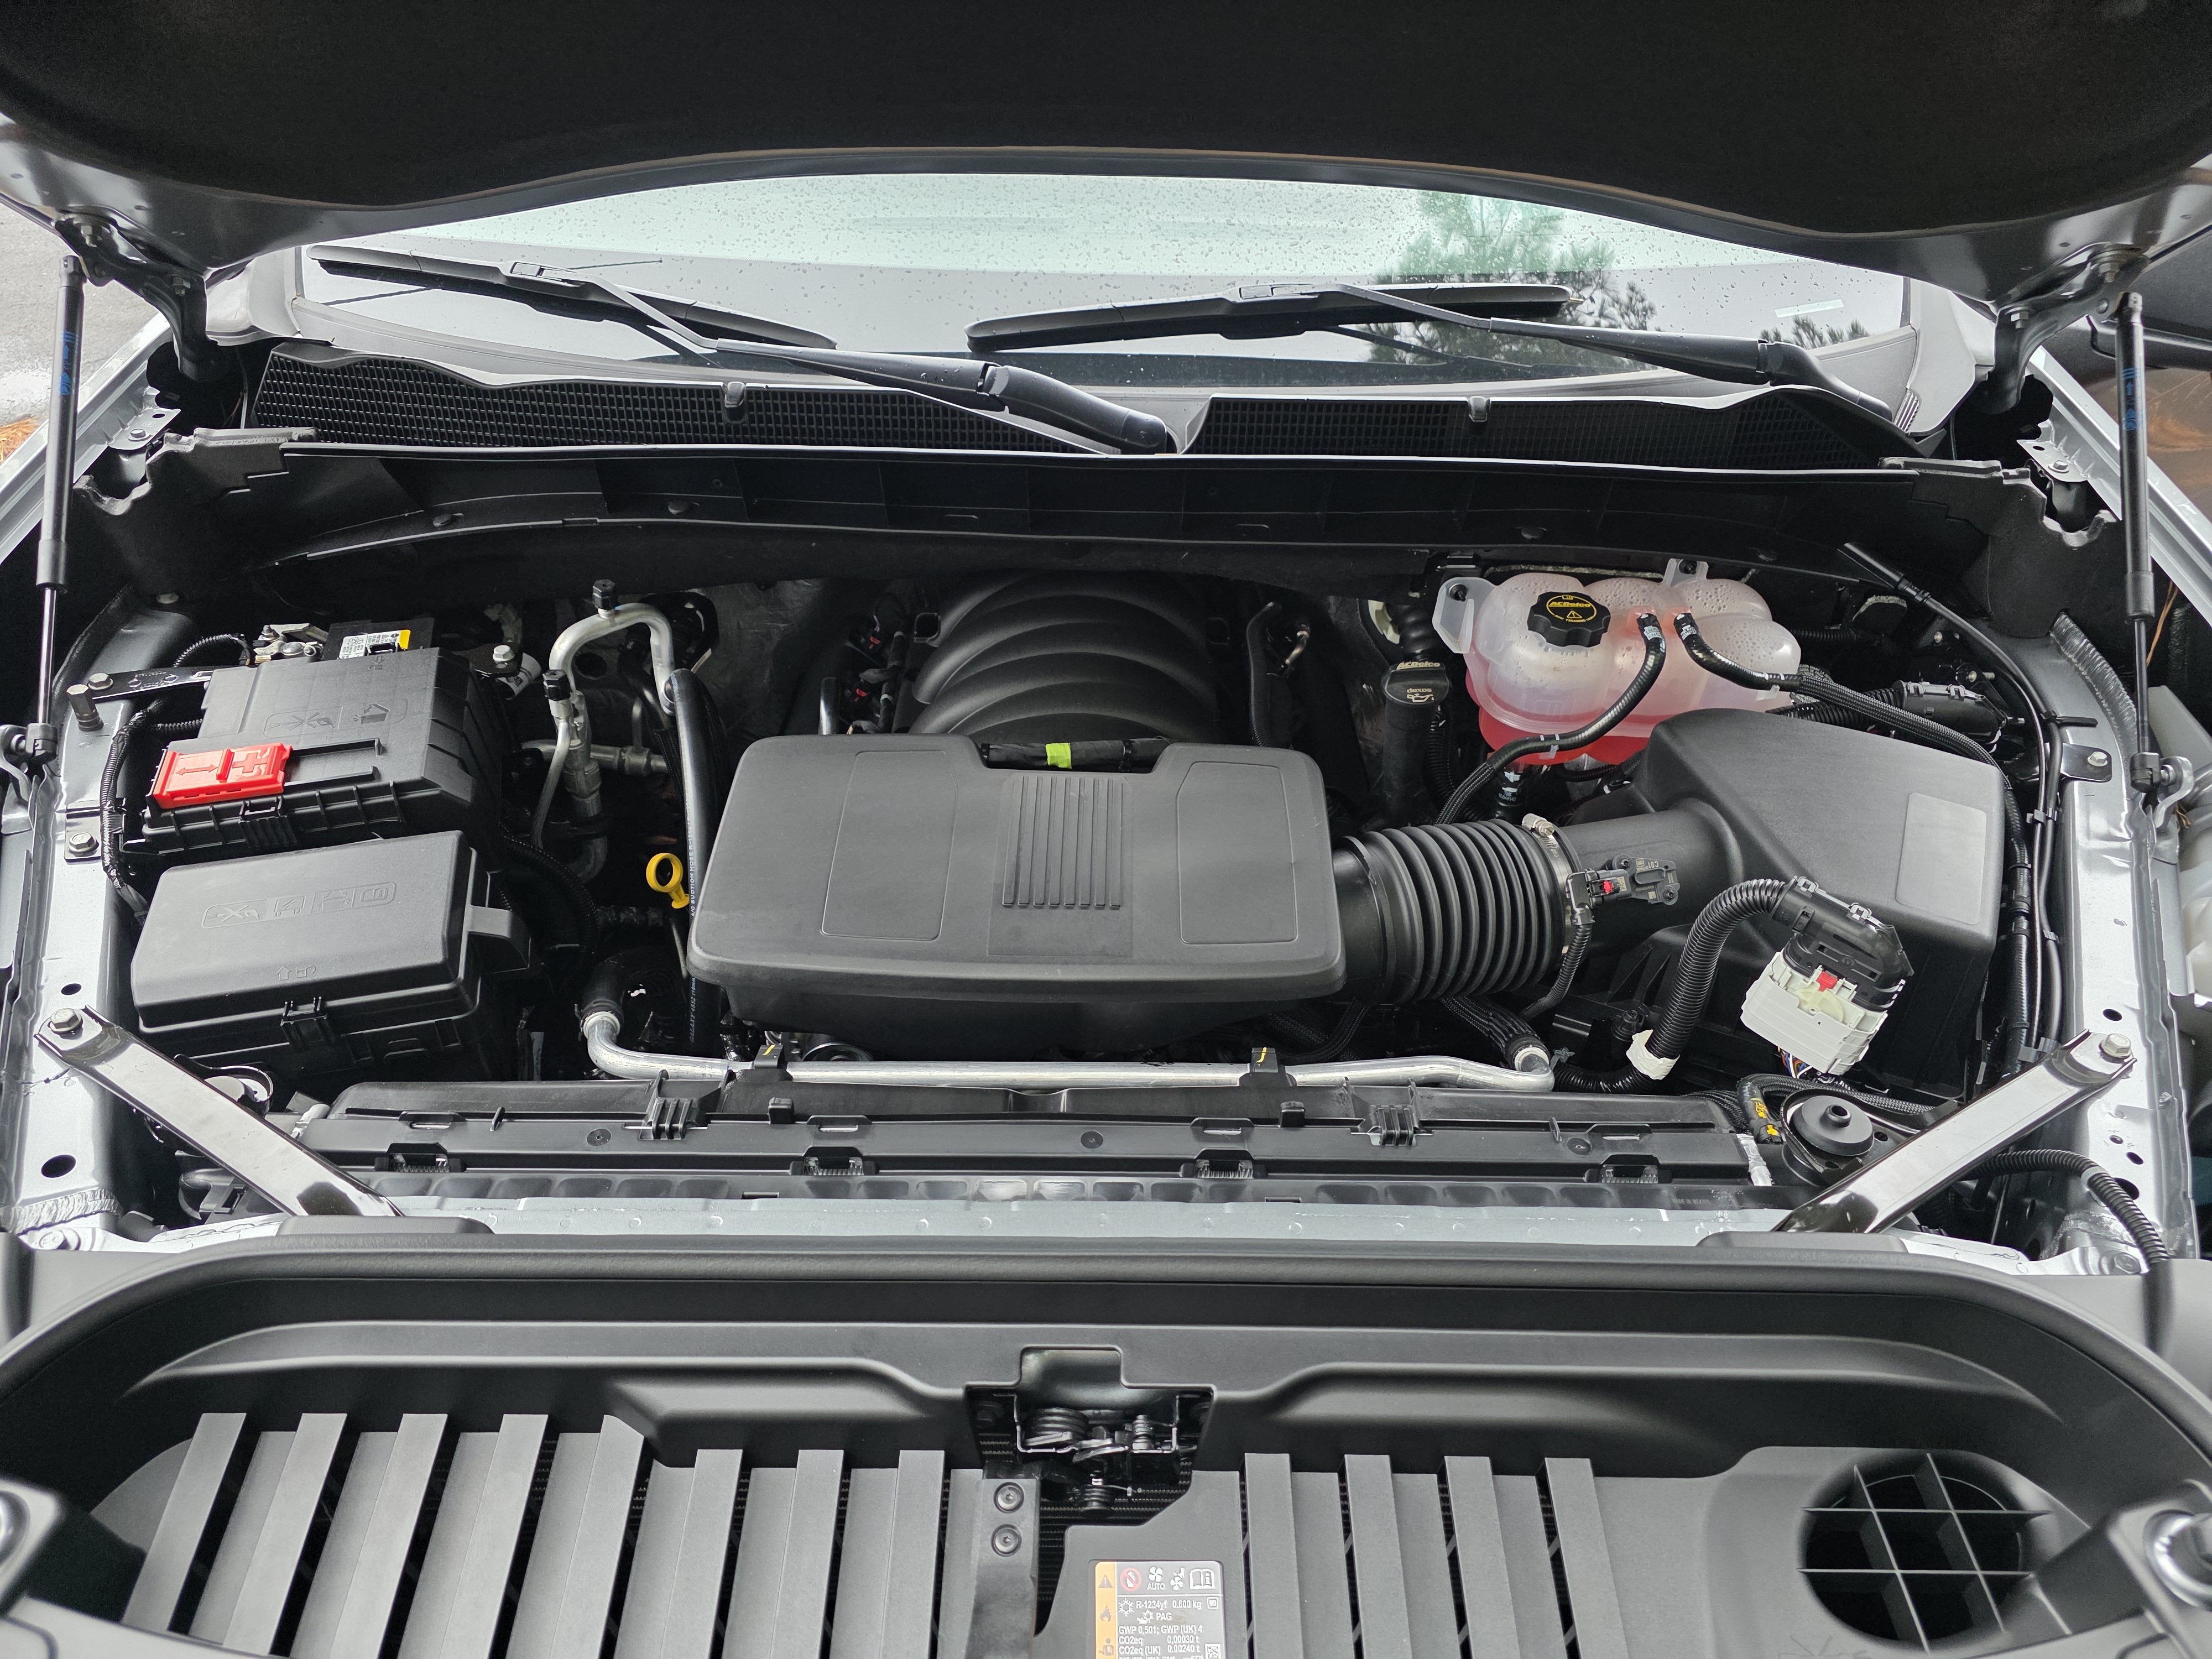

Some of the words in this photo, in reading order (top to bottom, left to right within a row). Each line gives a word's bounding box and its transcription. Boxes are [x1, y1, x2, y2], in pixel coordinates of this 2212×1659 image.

[1396, 661, 1441, 670] ACDelco
[1648, 860, 1658, 869] C01
[1136, 1600, 1167, 1611] R-1234yf
[1172, 1600, 1191, 1608] 0.600
[1192, 1600, 1202, 1610] kg
[1156, 1612, 1172, 1620] PAG
[1118, 1626, 1136, 1634] GWP
[1138, 1626, 1159, 1635] 0,501;
[1180, 1625, 1196, 1635] (UK)
[1118, 1636, 1143, 1646] CO2eq
[1167, 1636, 1194, 1645] 0,00030
[1118, 1646, 1144, 1656] CO2eq
[1144, 1646, 1160, 1656] (UK)
[1167, 1645, 1194, 1653] 0.00240
[1196, 1645, 1200, 1653] t
